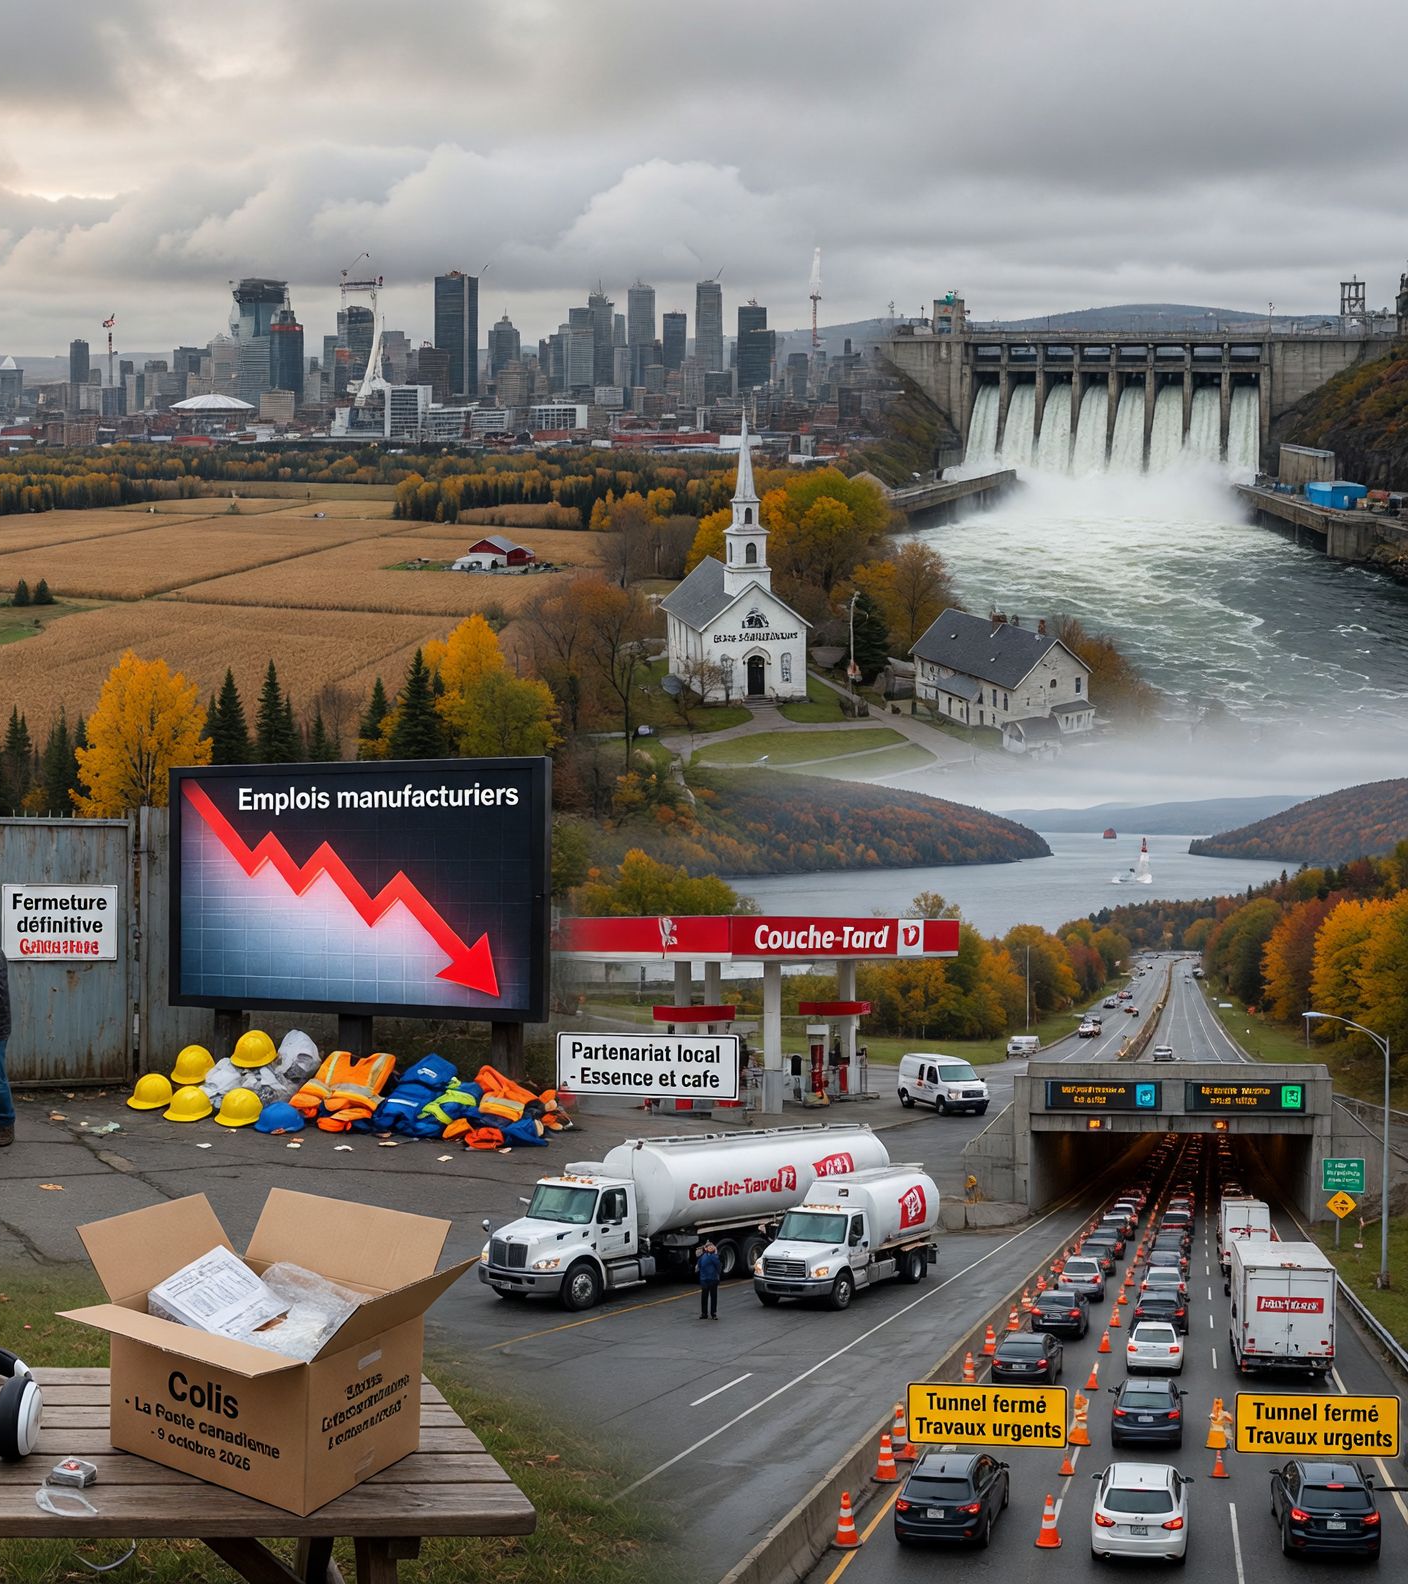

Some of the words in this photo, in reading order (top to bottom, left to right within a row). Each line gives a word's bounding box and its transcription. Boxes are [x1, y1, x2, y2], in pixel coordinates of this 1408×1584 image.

[238, 786, 330, 815] Emplois
[337, 782, 519, 808] manufacturiers
[12, 893, 107, 910] Fermeture
[17, 916, 103, 933] définitive
[754, 924, 890, 950] Couche-Tard
[571, 1042, 672, 1062] Partenariat
[677, 1044, 720, 1063] local
[580, 1067, 653, 1087] Essence
[658, 1070, 677, 1087] et
[682, 1070, 720, 1088] cafe
[135, 1396, 151, 1415] La
[168, 1371, 239, 1419] Colis
[926, 1392, 986, 1412] Tunnel
[993, 1394, 1046, 1413] fermé
[1253, 1402, 1317, 1421] Tunnel
[1324, 1403, 1379, 1422] fermé
[157, 1427, 165, 1440] 9
[915, 1417, 986, 1436] Travaux
[993, 1422, 1061, 1441] urgents
[1245, 1426, 1317, 1445] Travaux
[1324, 1430, 1392, 1450] urgents
